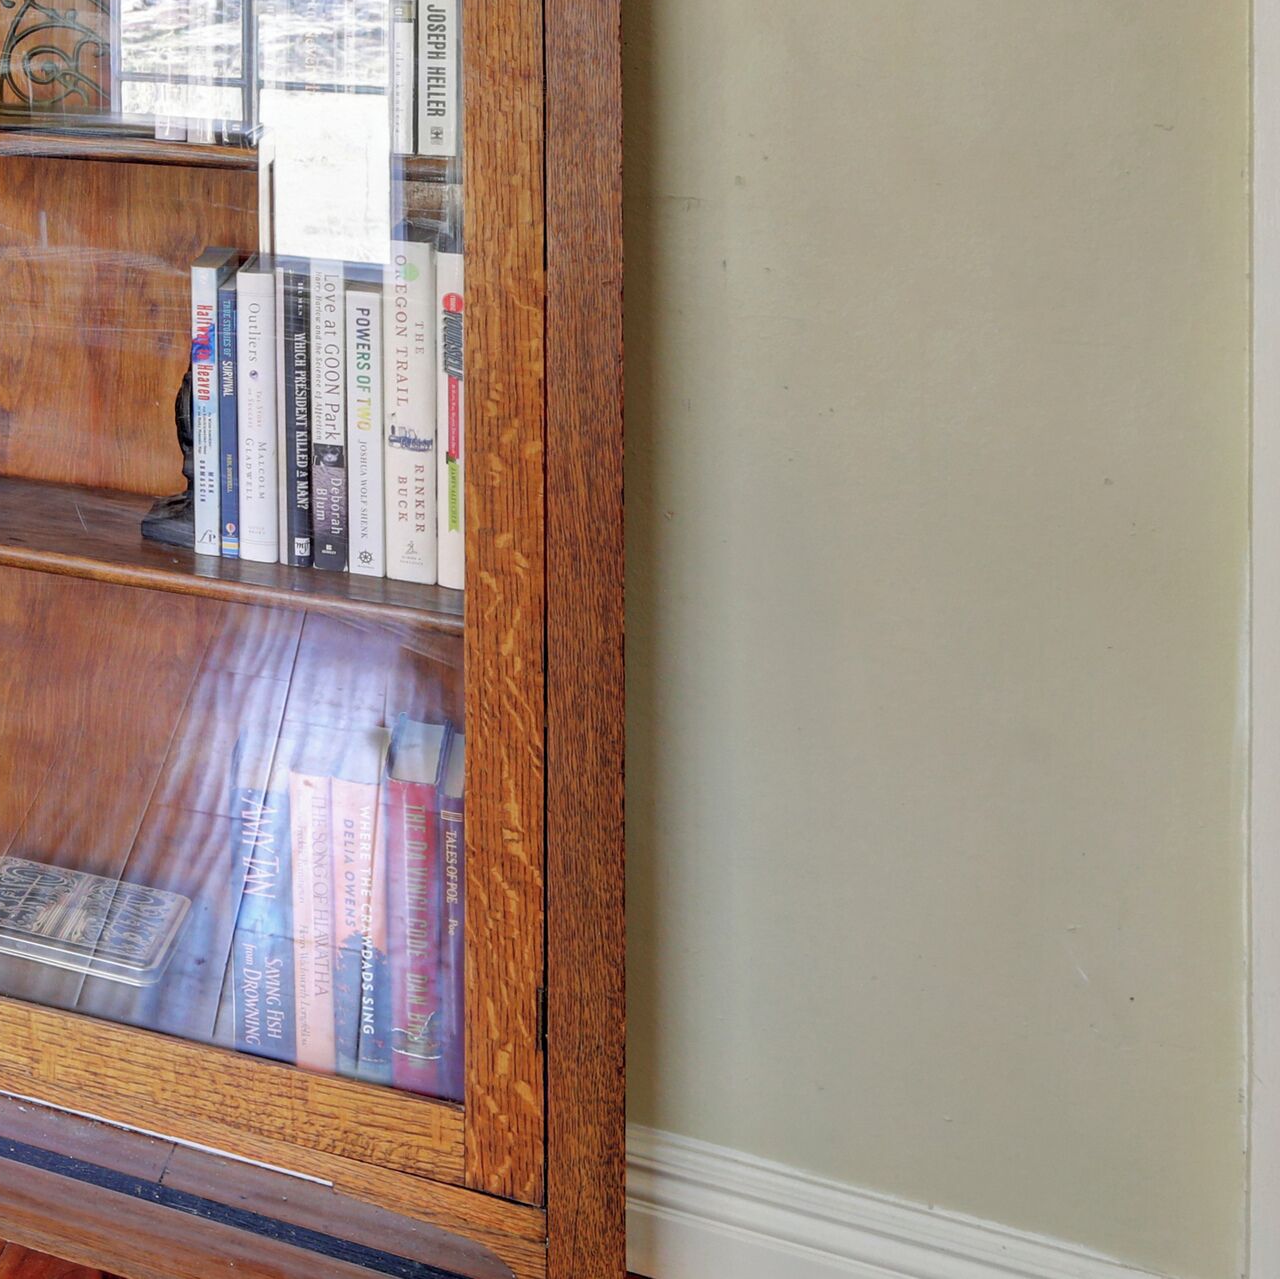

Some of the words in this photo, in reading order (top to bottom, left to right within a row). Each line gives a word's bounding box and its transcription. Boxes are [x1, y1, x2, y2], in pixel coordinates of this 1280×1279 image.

[427, 4, 447, 60] JOSEPH
[427, 63, 446, 118] HELLER
[223, 300, 232, 318] TRUE
[322, 274, 340, 313] Love
[394, 255, 409, 345] OREGON
[223, 319, 232, 343] STORIES
[247, 303, 261, 363] Outliers
[324, 320, 338, 336] at
[355, 307, 371, 371] POWERS
[414, 321, 424, 356] THE
[223, 345, 232, 357] OF
[294, 332, 306, 368] WHICH
[222, 360, 234, 397] SURVIVAL
[315, 357, 323, 388] Science
[325, 344, 340, 395] GOON
[357, 375, 371, 393] OF
[395, 347, 409, 408] TRAIL
[294, 370, 308, 429] PRESIDENT
[357, 397, 372, 432] TWO
[325, 402, 341, 441] Park
[295, 431, 308, 468] KILLED
[359, 439, 368, 477] JOSHUA
[244, 438, 255, 501] GLADWELL
[257, 441, 267, 500] MALCOLM
[296, 480, 309, 510] MAN?
[315, 488, 328, 521] Blum
[330, 478, 344, 534] Deborah
[359, 480, 368, 502] WOLF
[397, 476, 408, 523] BUCK
[414, 465, 425, 534] RINKER
[359, 504, 368, 539] SHENK
[240, 797, 278, 854] AMY
[311, 795, 330, 827] THE
[404, 805, 426, 831] THE
[343, 818, 355, 865] DELIA
[359, 806, 371, 861] WHERE
[406, 842, 427, 860] DA
[445, 830, 457, 864] TALES
[312, 832, 330, 879] SONG
[446, 866, 457, 882] OF
[243, 856, 280, 899] TAN
[313, 882, 328, 906] OF
[360, 868, 372, 898] THE
[406, 868, 428, 912] VINCI
[446, 883, 458, 903] POE
[344, 871, 356, 928] OWENS
[406, 918, 429, 958] CODE
[447, 919, 458, 936] Poe
[243, 944, 256, 965] from
[313, 908, 331, 998] HIAWATHA
[360, 903, 373, 992] CRAWDADS
[265, 957, 284, 1006] SAVING
[406, 973, 428, 1005] DAN
[242, 967, 263, 1045] DROWNING
[266, 1010, 284, 1039] FISH
[362, 997, 374, 1035] SING
